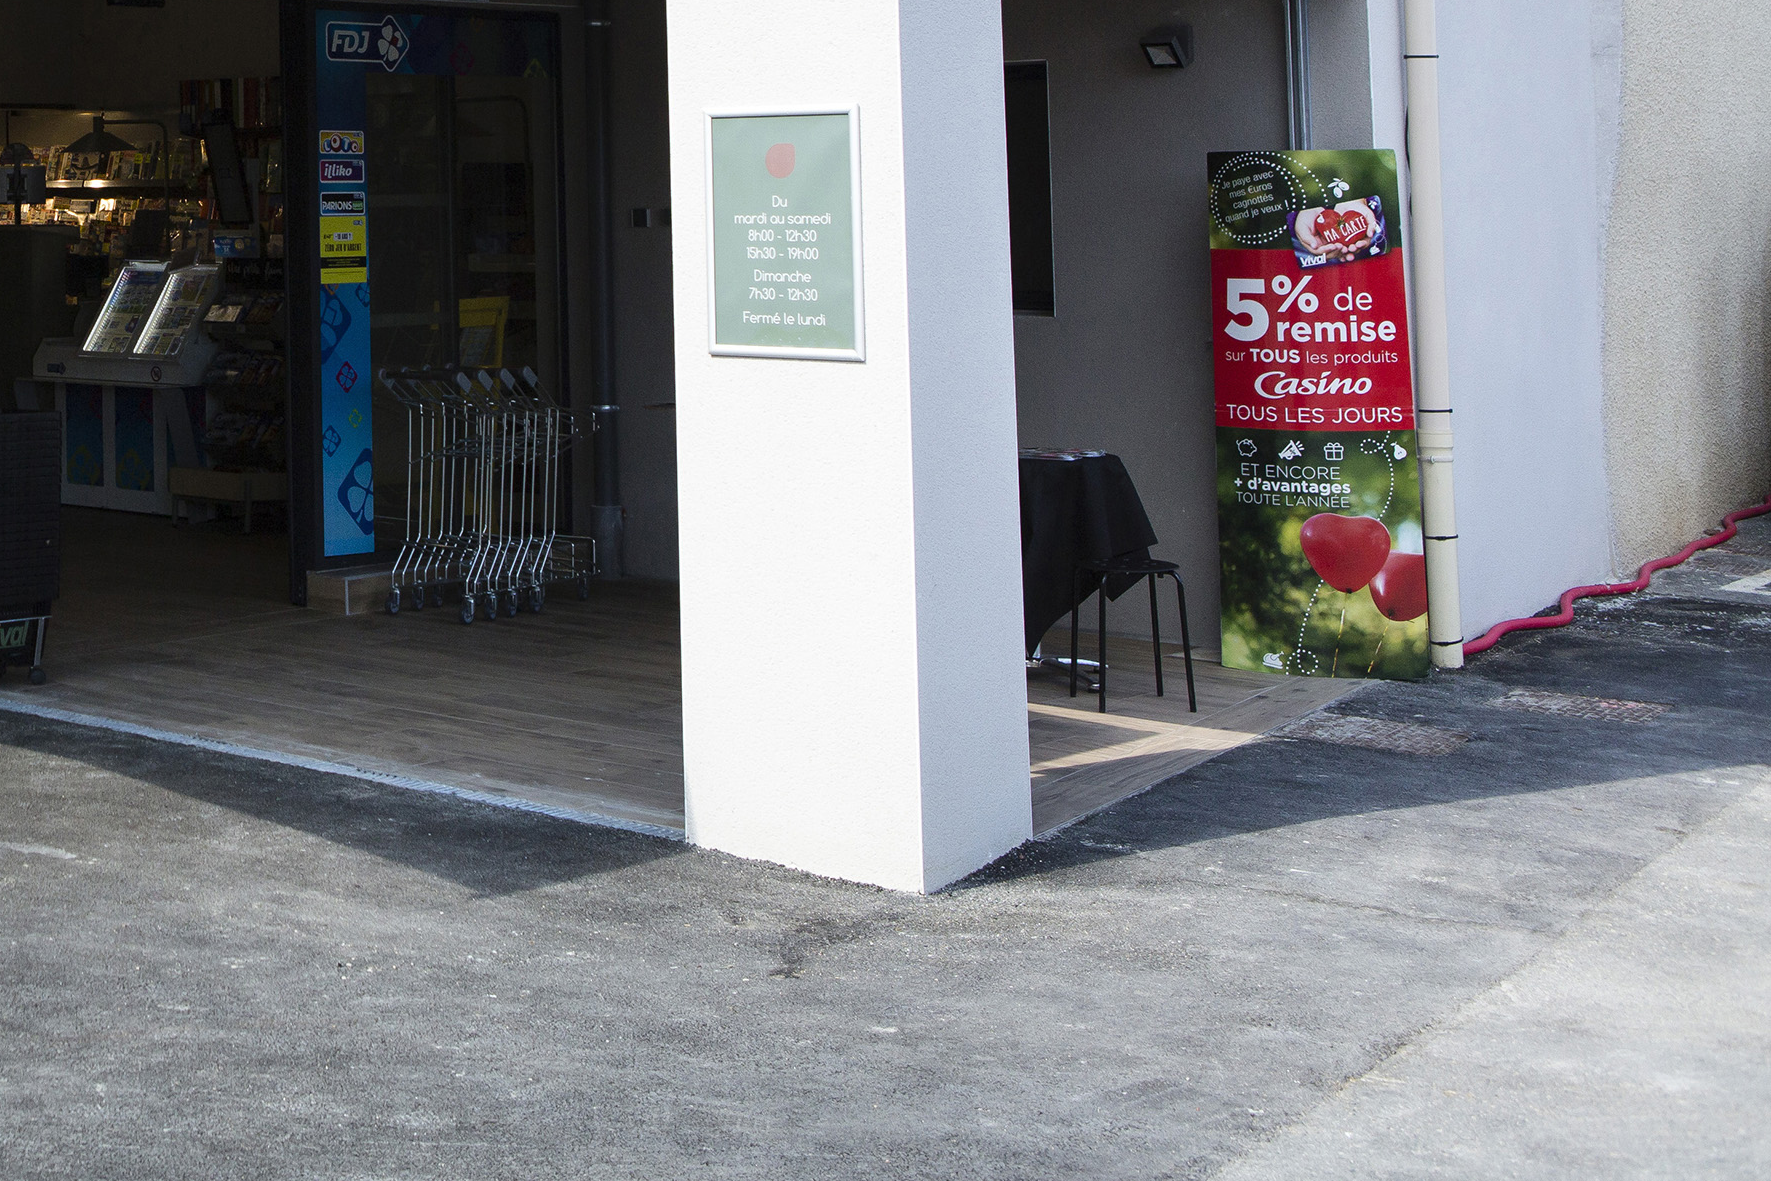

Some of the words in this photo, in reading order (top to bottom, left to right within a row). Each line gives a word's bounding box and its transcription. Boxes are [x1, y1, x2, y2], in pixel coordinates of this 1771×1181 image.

[331, 30, 370, 54] FDJ
[1221, 179, 1231, 190] Je
[1232, 175, 1251, 189] paye
[1252, 170, 1274, 182] avec
[772, 195, 788, 208] Du
[1229, 188, 1246, 199] mes
[1232, 193, 1274, 210] cagnottés
[322, 201, 353, 211] PARIONS
[1225, 210, 1250, 225] quand
[1250, 209, 1260, 219] je
[1261, 203, 1283, 214] veux
[1284, 199, 1290, 211] !
[734, 212, 767, 225] mardi
[770, 215, 785, 224] au
[787, 212, 831, 225] samedi
[748, 229, 774, 242] 8h00
[784, 229, 817, 242] 12h30
[1323, 228, 1340, 242] MA
[1339, 215, 1367, 236] CARTE
[746, 246, 776, 259] 15h30
[787, 247, 819, 260] 19h00
[753, 269, 812, 283] Dimanche
[748, 286, 776, 300] 7h30
[787, 288, 818, 301] 12h30
[1223, 274, 1320, 342] 5%
[1333, 286, 1373, 311] de
[742, 310, 781, 325] Fermé
[783, 312, 795, 325] le
[797, 312, 826, 326] lundi
[1277, 315, 1397, 343] remise
[1225, 350, 1245, 362] sur
[1249, 348, 1301, 364] TOUS
[1306, 349, 1328, 364] les
[1334, 348, 1398, 366] produits
[1254, 371, 1373, 400] Casino
[1226, 404, 1278, 422] TOUS
[1284, 407, 1325, 424] LES
[1332, 406, 1403, 424] JOURS
[1240, 462, 1260, 477] ET
[1265, 464, 1341, 481] ENCORE
[1234, 477, 1243, 487] +
[1247, 476, 1351, 496] d'avantages
[1236, 491, 1281, 506] TOUTE
[1285, 493, 1350, 508] L'ANNÉE
